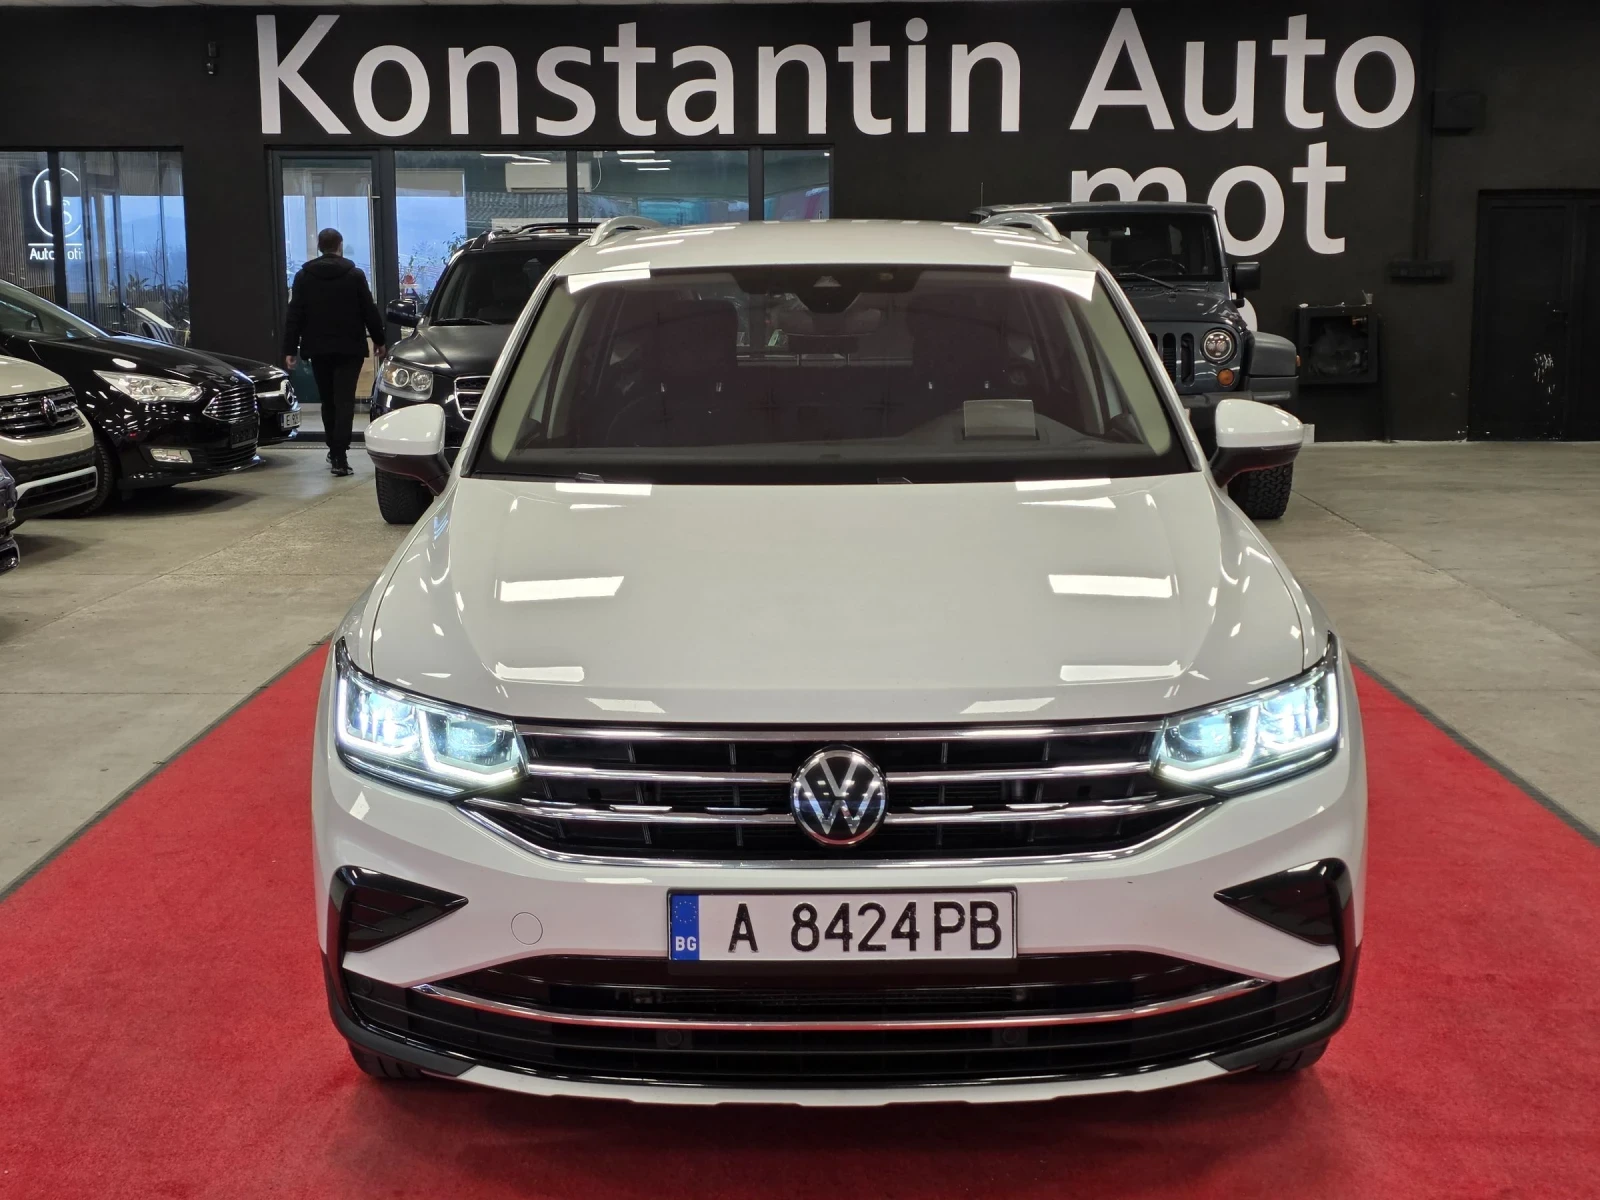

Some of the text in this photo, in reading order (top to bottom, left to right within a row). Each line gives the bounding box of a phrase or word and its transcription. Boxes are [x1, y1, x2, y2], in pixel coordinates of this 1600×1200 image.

[256, 8, 1416, 137] Konstantin Auto
[675, 936, 698, 952] BG
[729, 903, 758, 952] A
[791, 902, 919, 952] 8424
